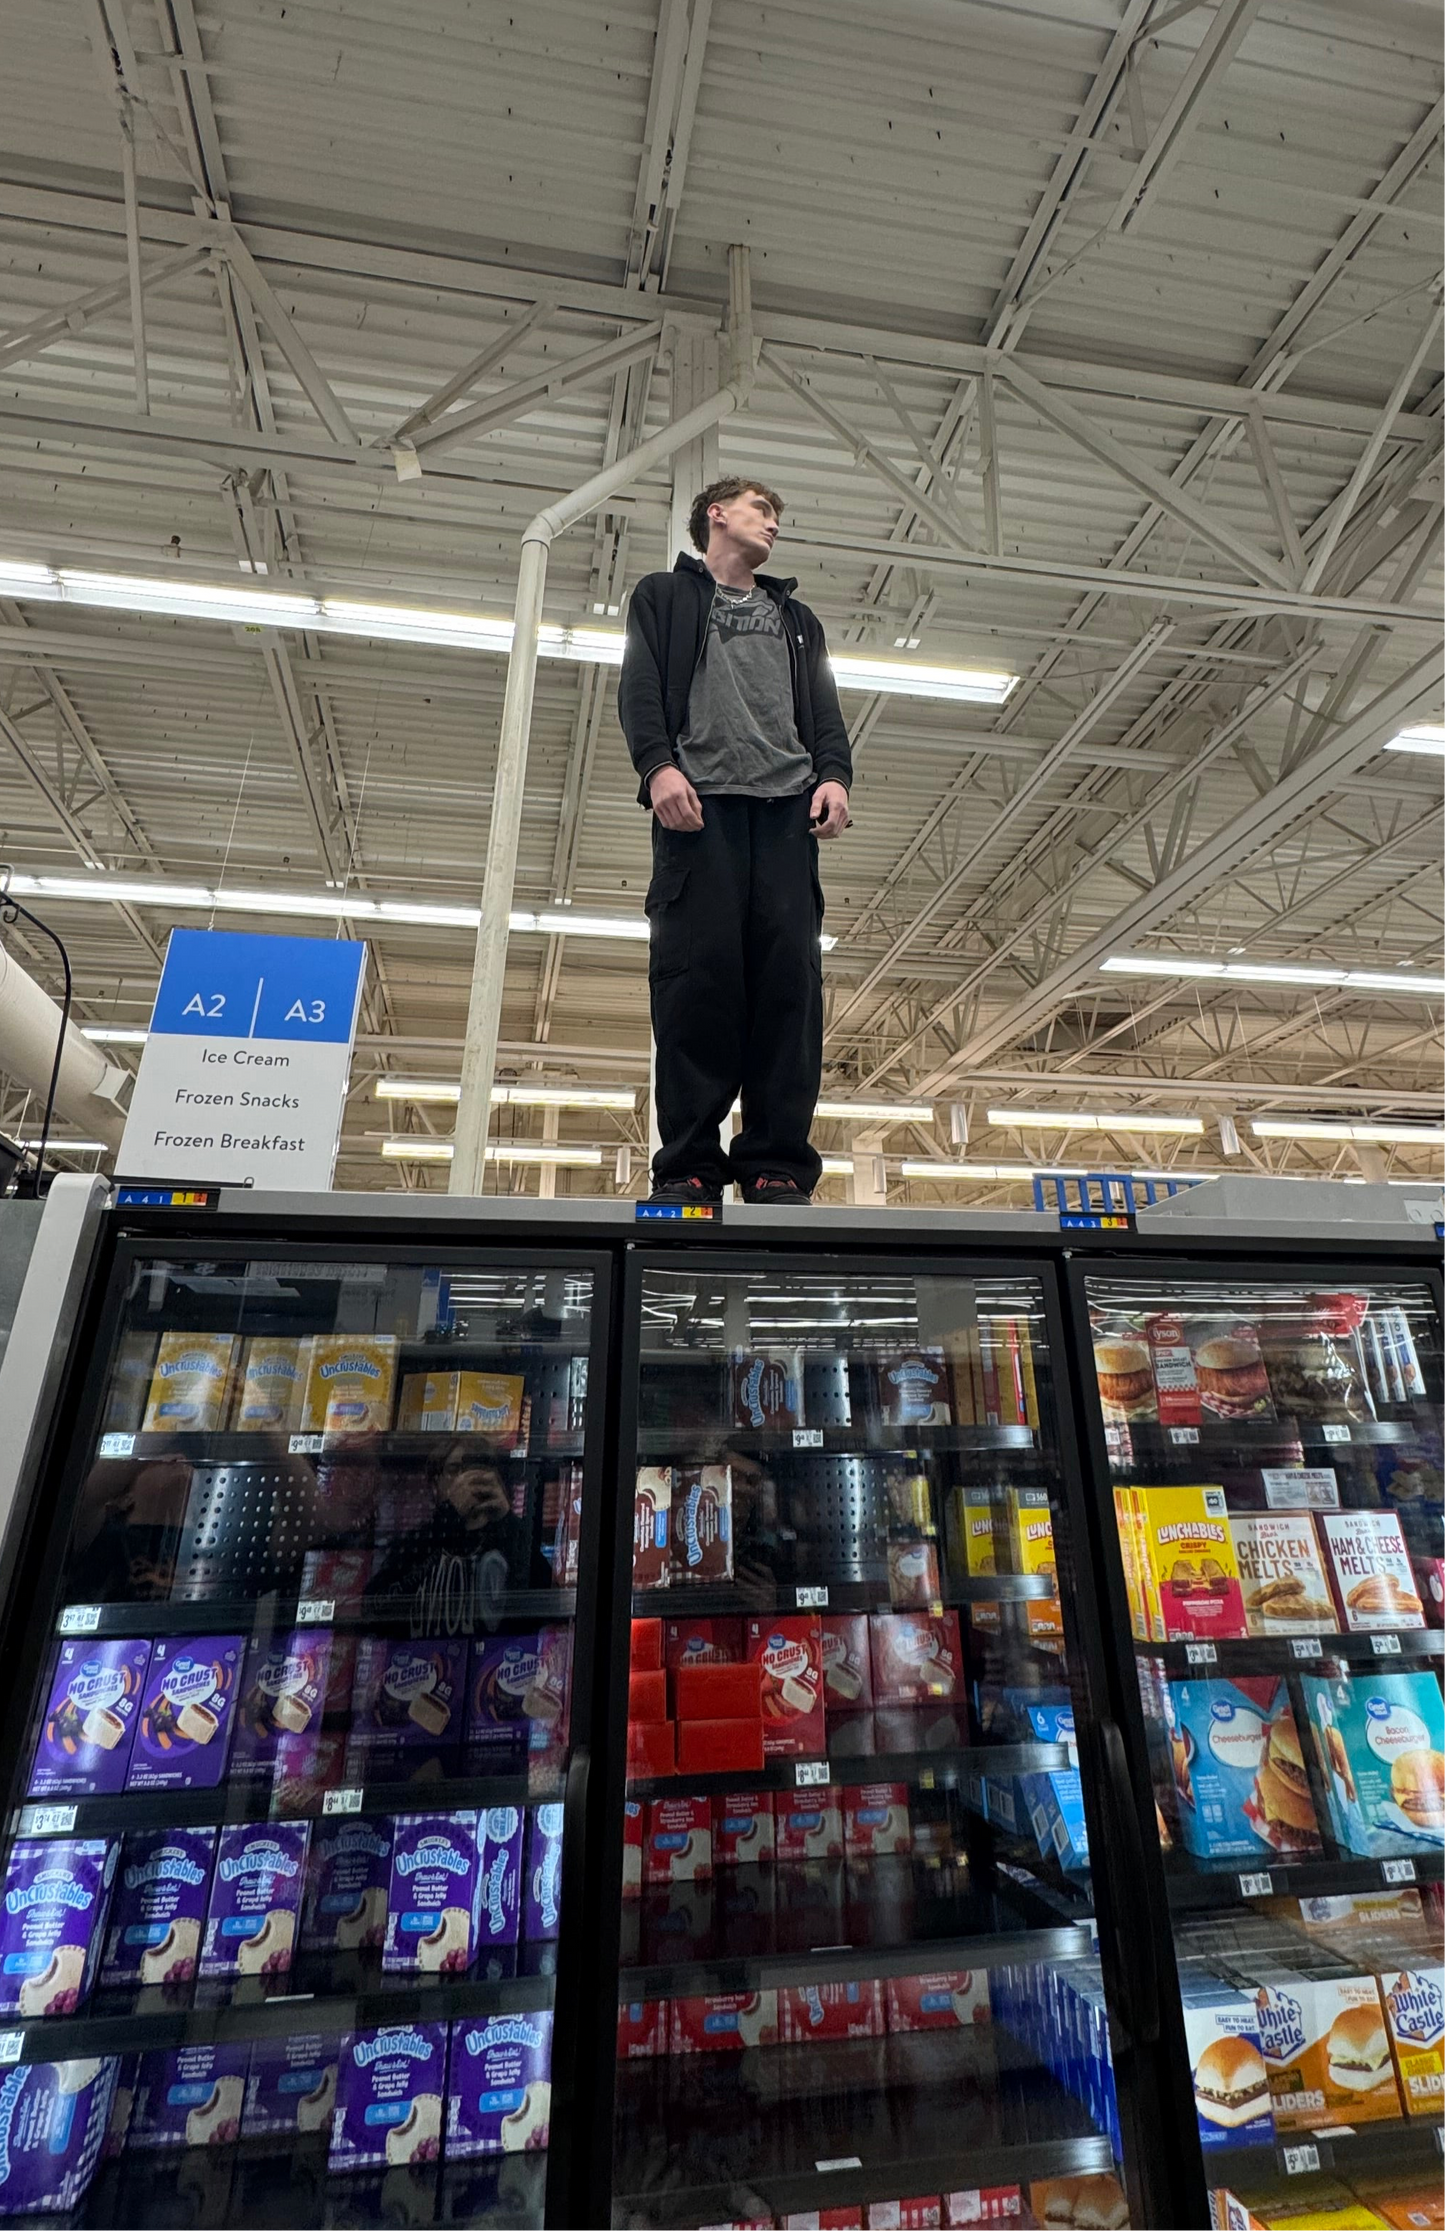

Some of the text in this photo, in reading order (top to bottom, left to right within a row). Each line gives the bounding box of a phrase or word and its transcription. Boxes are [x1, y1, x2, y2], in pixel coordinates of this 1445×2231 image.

[182, 993, 226, 1018] A2
[284, 1000, 326, 1023] A3
[202, 1049, 290, 1068] Ice Cream
[175, 1089, 300, 1109] Frozen Snacks
[154, 1131, 305, 1152] Frozen Breakfast
[125, 1195, 133, 1203] A
[142, 1196, 149, 1204] 4
[642, 1209, 650, 1217] A
[656, 1209, 663, 1218] 4
[671, 1210, 676, 1218] 2
[690, 1206, 696, 1216] 2
[1106, 1216, 1113, 1227] 3
[159, 1361, 223, 1379] Uncrustables
[319, 1360, 381, 1379] Uncrustables
[888, 1367, 939, 1385] Uncrustables
[750, 1358, 765, 1427] Uncrustables
[685, 1484, 703, 1567] Uncrustables
[1248, 1524, 1290, 1532] SANDWICH
[1157, 1523, 1225, 1545] LUNCHABLES
[1180, 1542, 1207, 1550] CRISPY
[1237, 1539, 1310, 1559] CHICKEN
[1331, 1535, 1404, 1556] HAM & CHEESE
[1238, 1561, 1293, 1580] MELTS
[1340, 1557, 1386, 1576] MELTS
[1352, 1611, 1358, 1622] 6
[670, 1626, 677, 1637] 4
[752, 1624, 758, 1634] 4
[1240, 1627, 1247, 1637] 2
[65, 1648, 74, 1659] 4
[157, 1645, 166, 1656] 4
[763, 1644, 806, 1664] NO CRUST
[257, 1667, 272, 1682] NO
[384, 1662, 436, 1683] NO CRUST
[497, 1657, 546, 1679] NO CRUST
[69, 1671, 125, 1695] NO CRUST
[162, 1667, 218, 1691] NO CRUST
[304, 1685, 317, 1698] 8G
[1181, 1686, 1189, 1701] 4
[1337, 1685, 1345, 1699] 4
[119, 1698, 133, 1711] 8G
[211, 1694, 226, 1707] 8G
[1036, 1712, 1045, 1725] 6
[1212, 1732, 1263, 1744] Cheeseburger
[1385, 1726, 1409, 1735] Bacon
[1375, 1734, 1425, 1745] Cheeseburger
[220, 1851, 298, 1881] Uncrustables
[395, 1848, 470, 1876] Uncrustables
[124, 1859, 205, 1888] Uncrustables
[432, 1884, 448, 1892] Butter
[489, 1849, 508, 1934] Uncrustables
[541, 1842, 561, 1928] Uncrustables
[6, 1881, 93, 1913] Uncrustables
[417, 1899, 441, 1907] Sandwich
[418, 1892, 433, 1901] Grape
[1359, 1909, 1400, 1922] SLIDERS
[22, 1922, 43, 1930] Peanut
[26, 1938, 54, 1946] Sandwich
[28, 1931, 48, 1940] Grape
[1393, 1990, 1437, 2012] White
[1218, 2016, 1232, 2024] EASY
[1397, 2010, 1444, 2034] Castle
[466, 2021, 543, 2055] Uncrustables
[1262, 2027, 1304, 2051] astle
[354, 2033, 433, 2066] Uncrustables
[484, 2060, 522, 2071] Peanut Butter
[372, 2073, 410, 2083] Peanut Butter
[490, 2078, 516, 2086] Sandwich
[491, 2071, 508, 2080] Grape
[377, 2090, 403, 2098] Sandwich
[378, 2082, 395, 2092] Grape
[1272, 2090, 1325, 2112] LIDERS
